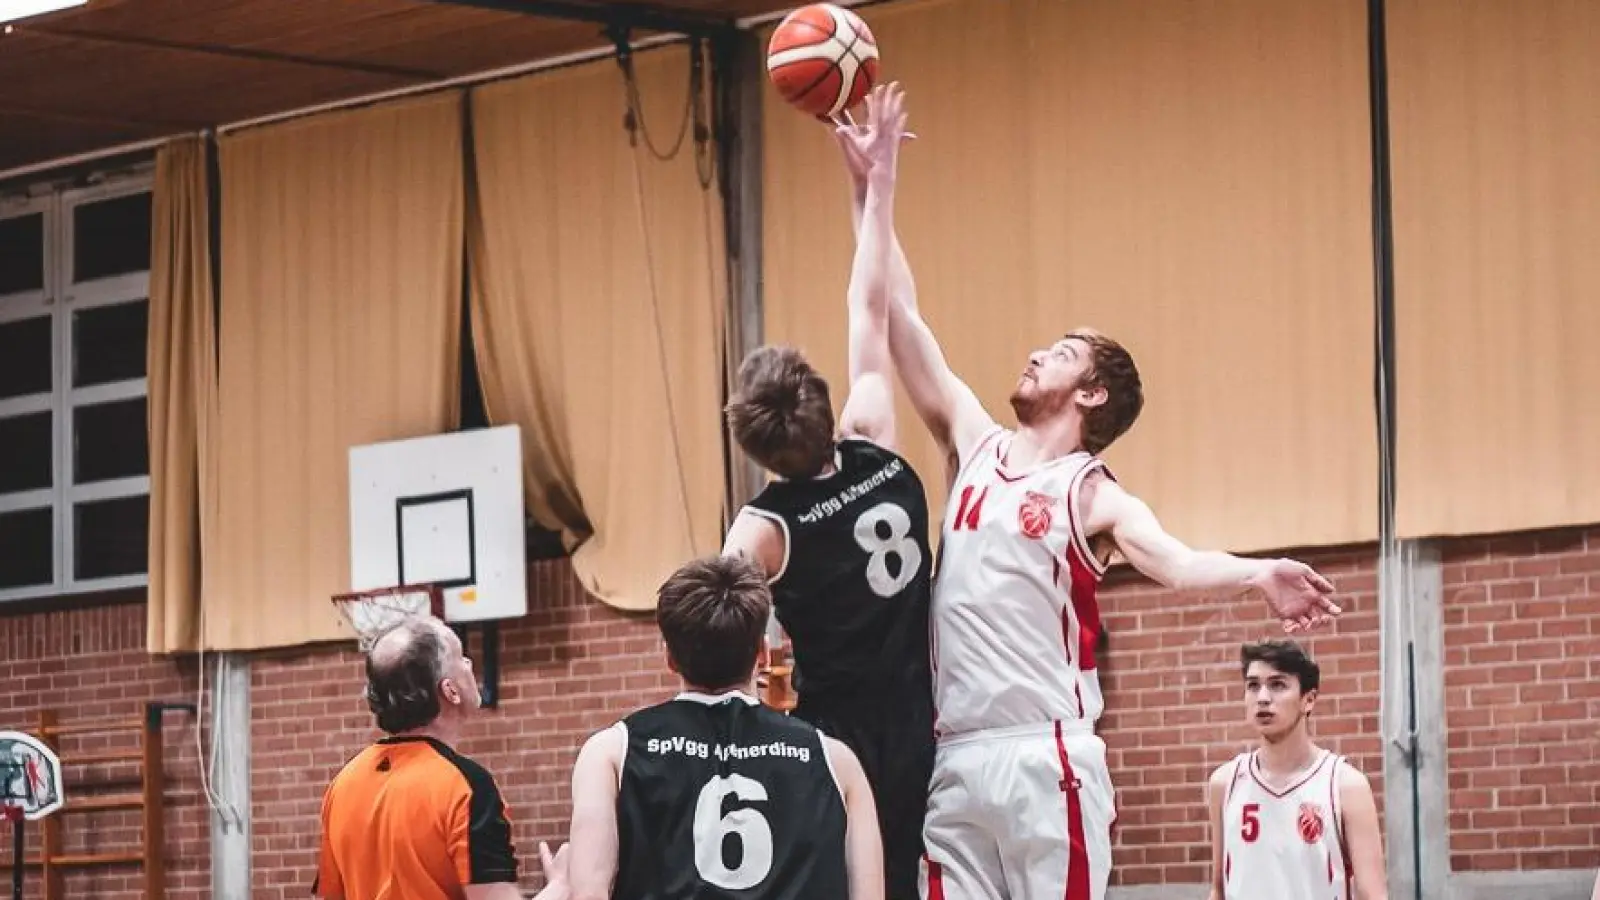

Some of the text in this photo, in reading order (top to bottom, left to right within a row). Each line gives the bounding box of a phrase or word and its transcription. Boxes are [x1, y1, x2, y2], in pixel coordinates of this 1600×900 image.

[953, 485, 988, 531] 14
[853, 502, 922, 598] 8
[647, 736, 709, 759] SpVgg
[693, 773, 774, 890] 6
[1241, 803, 1260, 843] 5
